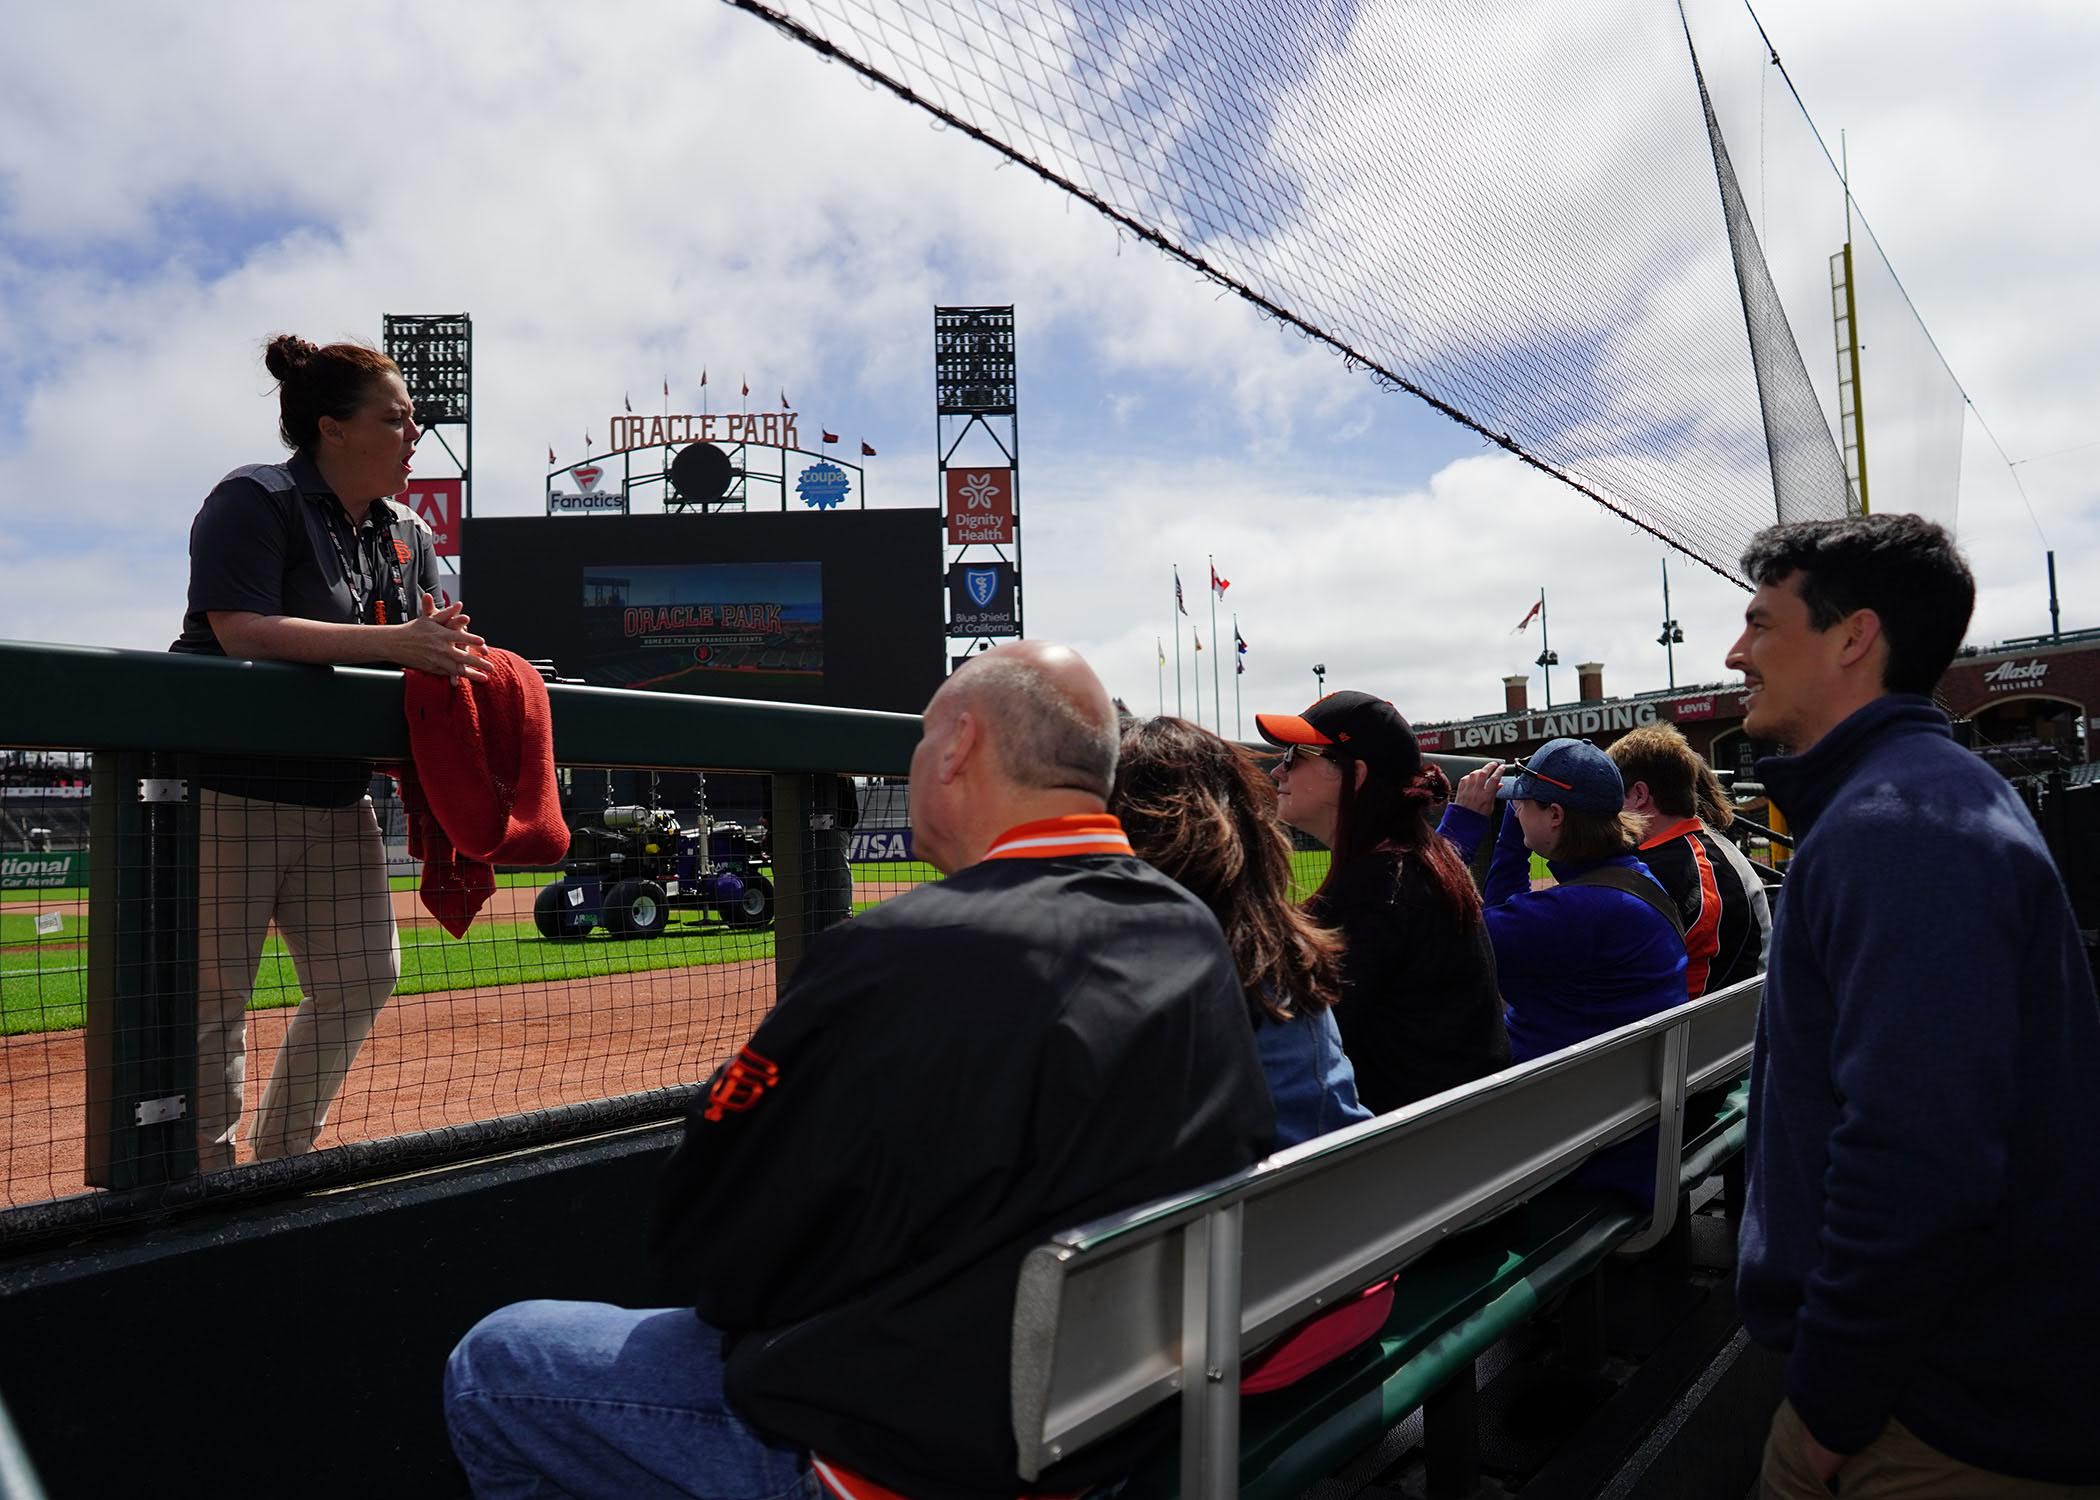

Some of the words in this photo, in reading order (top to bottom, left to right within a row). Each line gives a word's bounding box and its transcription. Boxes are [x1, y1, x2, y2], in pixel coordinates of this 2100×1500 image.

[611, 415, 716, 454] ORACLE
[727, 413, 800, 450] PARK
[803, 470, 846, 486] coupa
[551, 493, 625, 508] Fanatics
[955, 514, 1004, 528] Dignity
[959, 529, 1003, 541] Health
[624, 606, 714, 637] ORACLE
[720, 604, 782, 633] PARK
[956, 613, 977, 623] Blue
[980, 612, 1010, 623] Shield
[953, 623, 965, 634] of
[966, 622, 1015, 634] California
[1984, 659, 2048, 682] Alaska
[1989, 680, 2044, 691] AIRLINES
[1526, 703, 1657, 740] LANDING
[1, 878, 23, 888] Car
[25, 876, 67, 887] Rental
